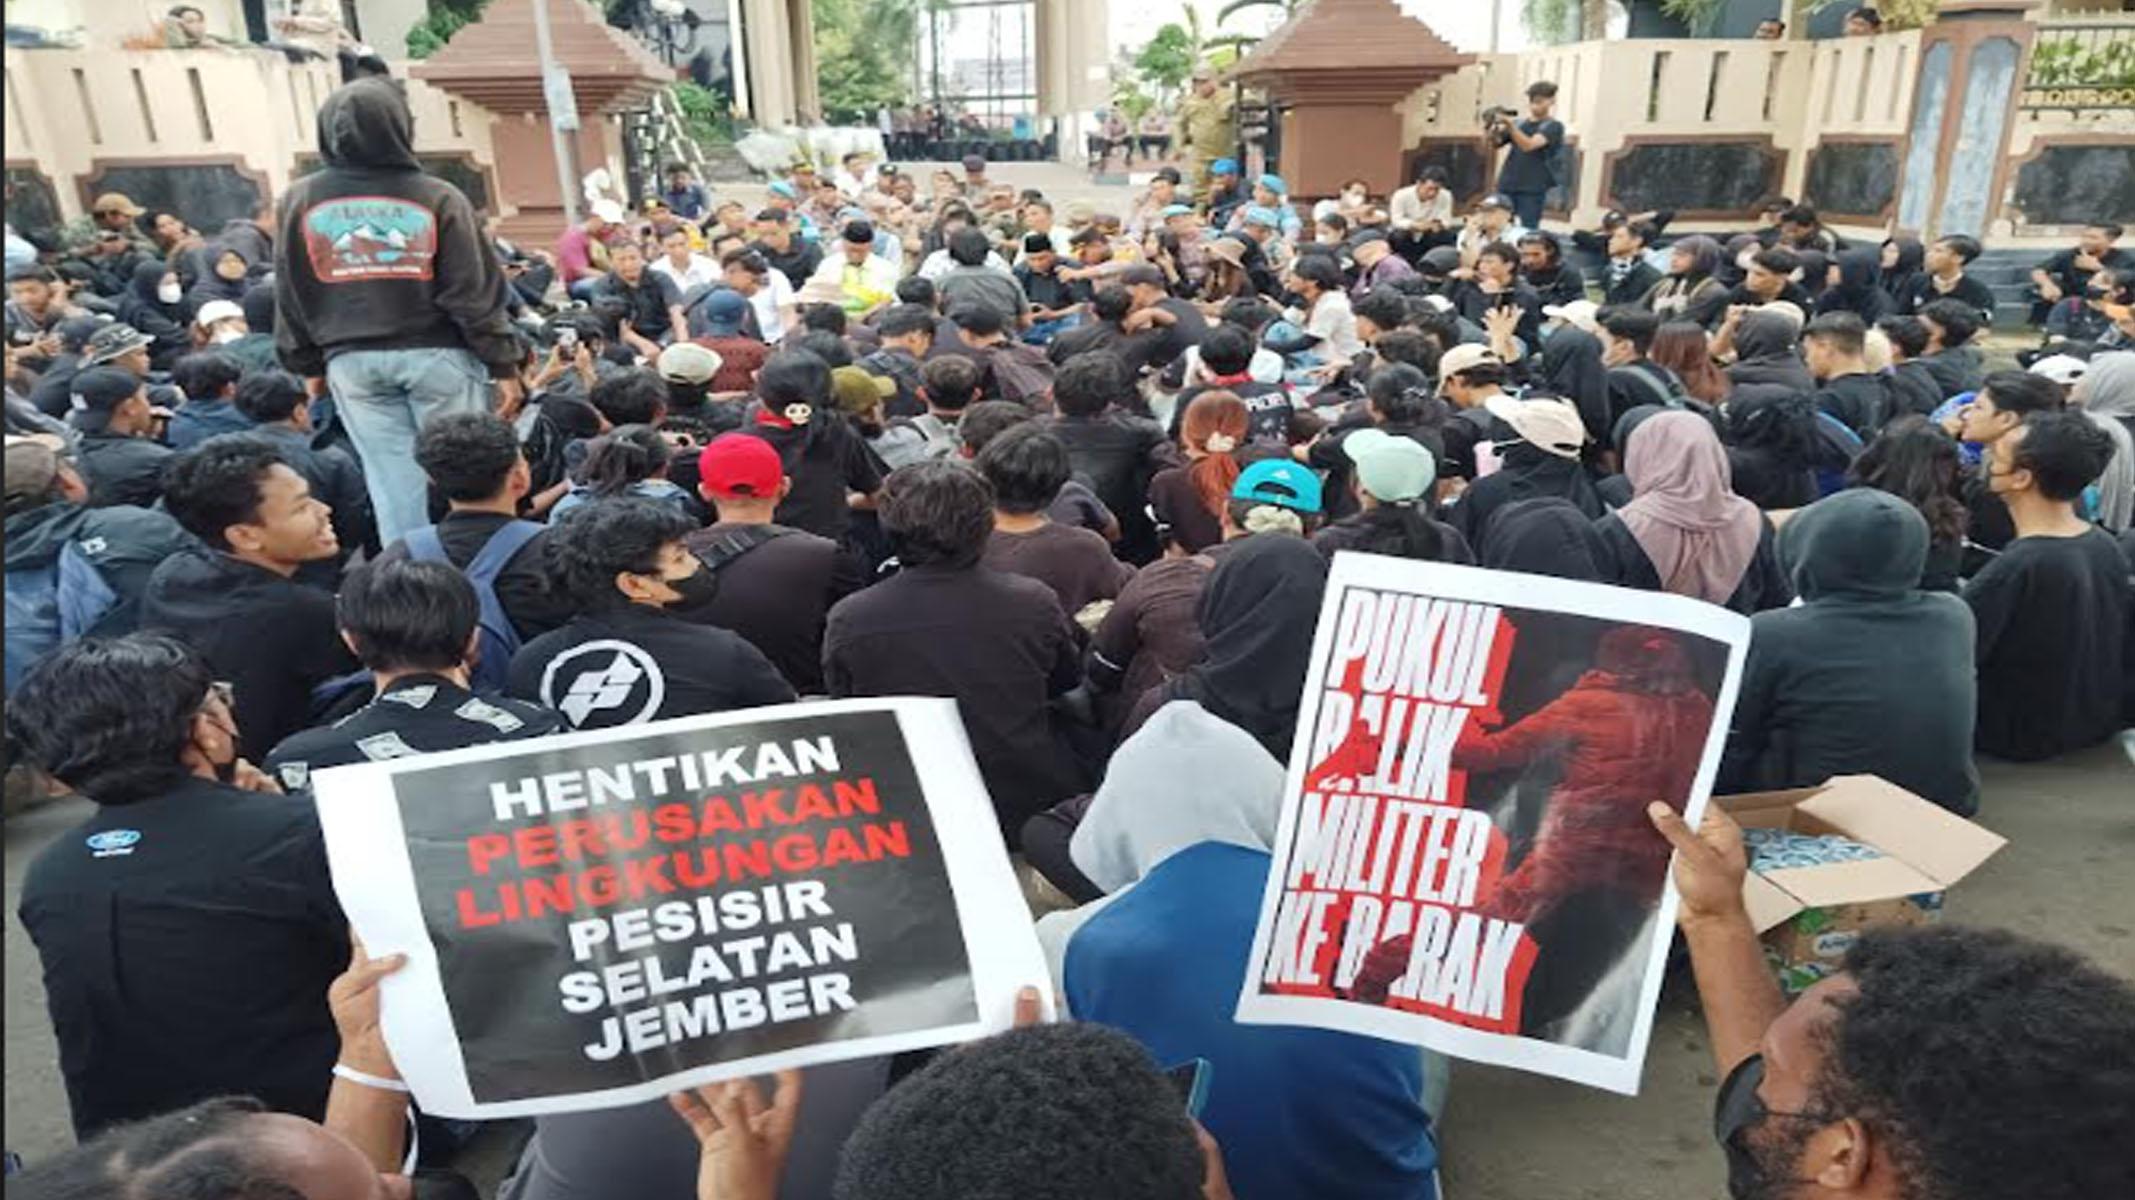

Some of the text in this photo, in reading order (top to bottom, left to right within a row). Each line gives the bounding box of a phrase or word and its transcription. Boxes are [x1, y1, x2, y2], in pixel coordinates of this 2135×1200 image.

[1326, 588, 1502, 706] PUKUL
[490, 736, 841, 820] HENTIKAN
[467, 777, 883, 875] PERUSAKAN
[1287, 792, 1492, 908] MILITER
[454, 821, 910, 929] LINGKUNGAN
[568, 880, 833, 961] PESISIR
[559, 923, 859, 1013] SELATAN
[1265, 890, 1339, 985] KE
[584, 973, 857, 1061] JEMBER
